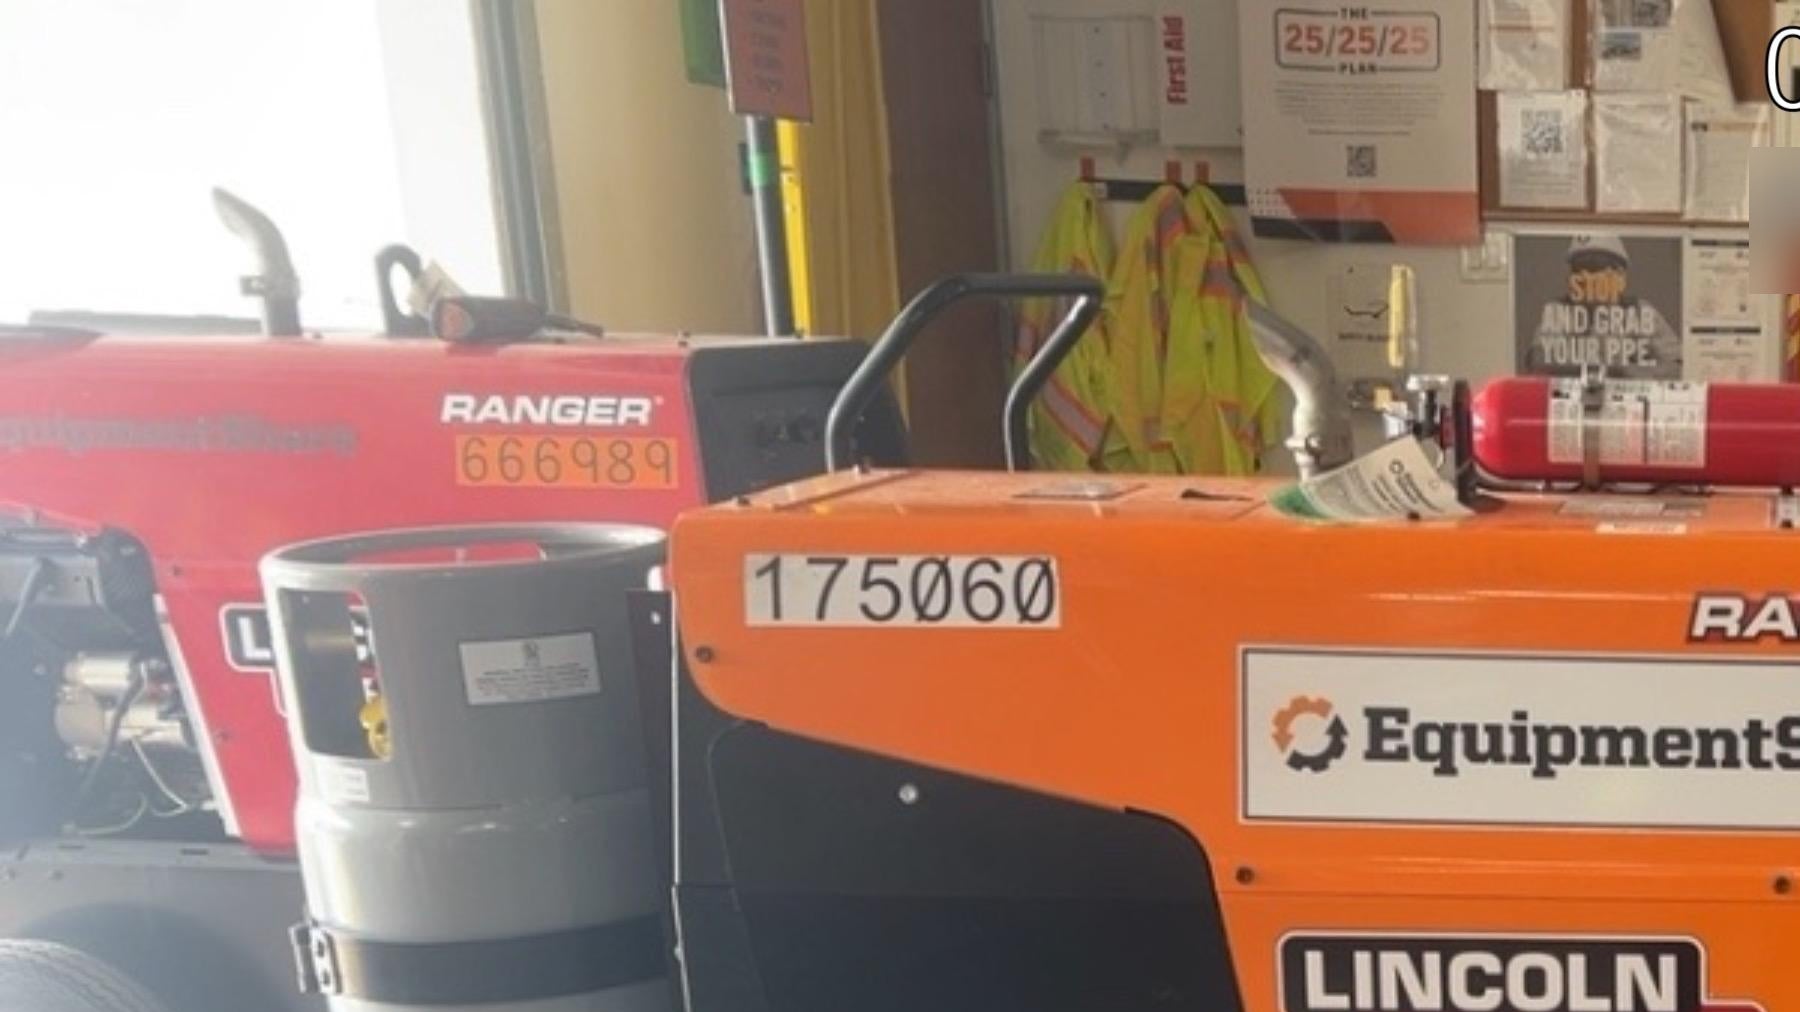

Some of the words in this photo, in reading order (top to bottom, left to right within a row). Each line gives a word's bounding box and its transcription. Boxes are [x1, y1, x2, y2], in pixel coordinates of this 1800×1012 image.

[1340, 8, 1369, 20] THE
[1161, 16, 1184, 52] Aid
[1285, 23, 1430, 57] 25/25/25
[1165, 57, 1187, 105] First
[1339, 62, 1378, 74] PLAN
[1541, 303, 1587, 335] AND
[1593, 303, 1656, 335] GRAB
[1541, 337, 1599, 366] YOUR
[1606, 338, 1657, 367] PPE.
[441, 394, 652, 426] RANGER
[461, 437, 672, 484] 666989
[755, 556, 1057, 624] 175060
[1304, 950, 1678, 1012] LINCOLN
